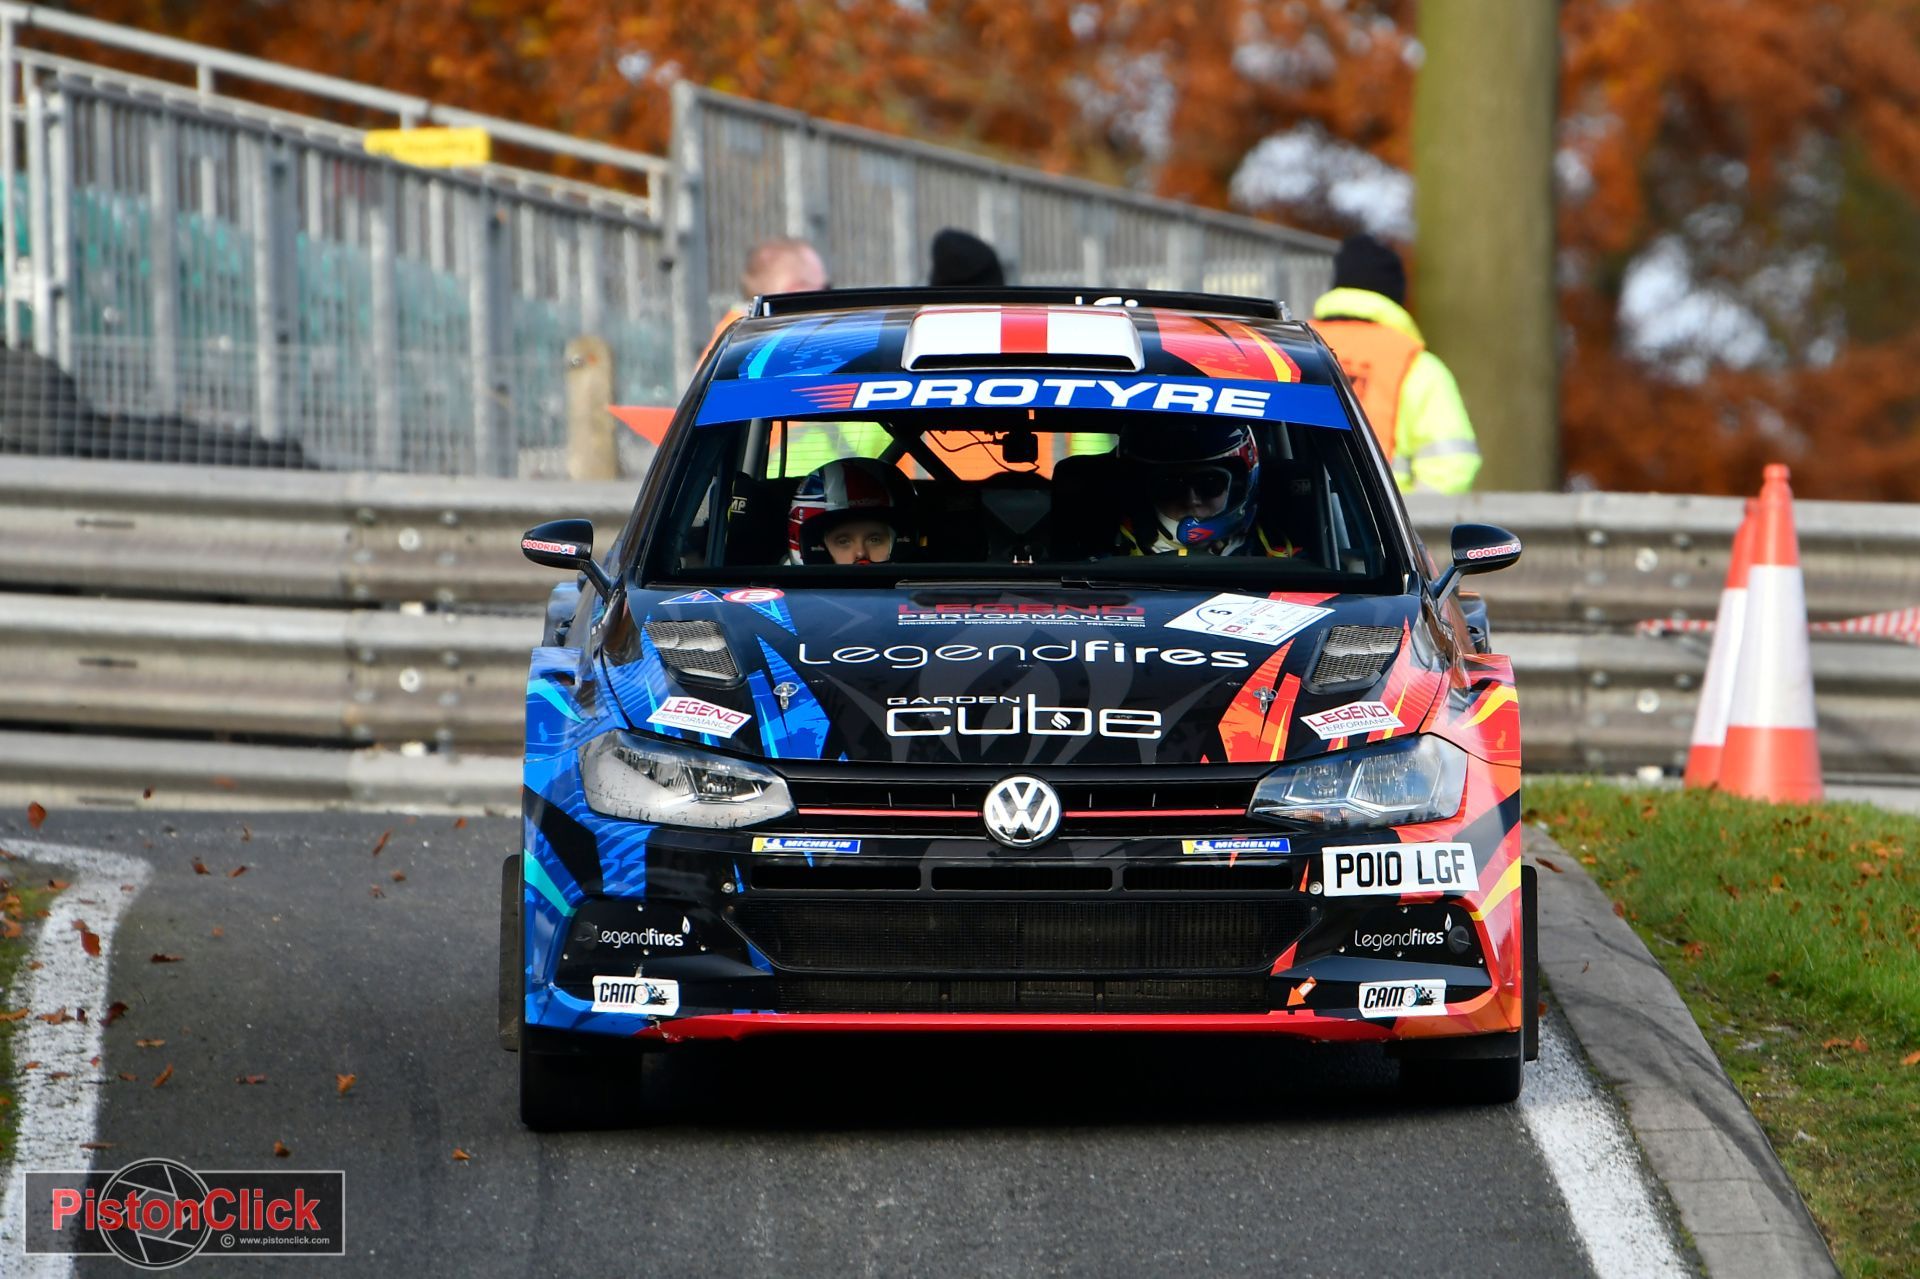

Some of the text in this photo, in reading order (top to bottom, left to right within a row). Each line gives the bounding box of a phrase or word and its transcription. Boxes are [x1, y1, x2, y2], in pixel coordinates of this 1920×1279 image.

[852, 378, 1270, 417] PROTYRE
[898, 603, 1146, 615] LEGEND
[898, 613, 1146, 622] PERFORMANCE
[886, 695, 1021, 706] GARDEN
[662, 700, 745, 725] LEGEND
[1306, 704, 1391, 728] LEGEND
[655, 712, 736, 732] PERFORMANCE
[1317, 716, 1398, 733] PERFORMANCE
[783, 839, 852, 849] MICHELIN
[1214, 839, 1281, 849] MICHELIN
[1335, 849, 1465, 889] PO10 LGF
